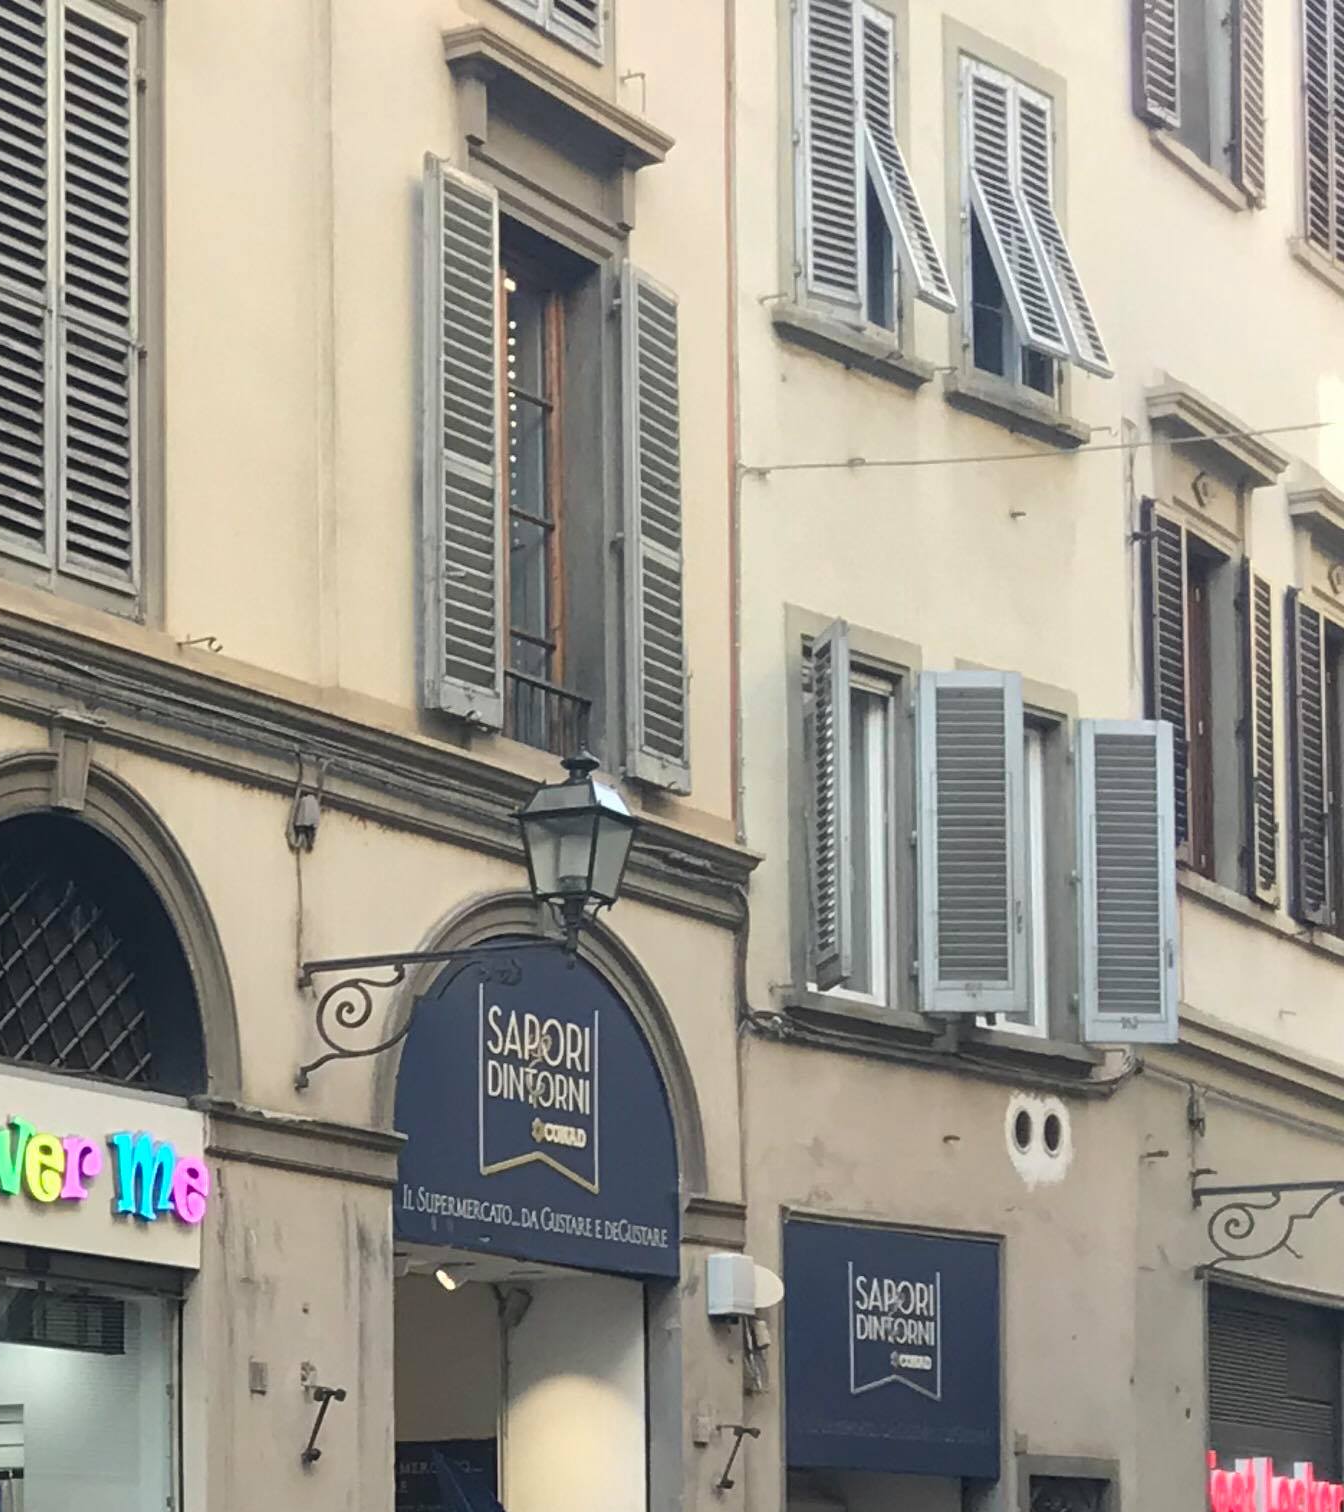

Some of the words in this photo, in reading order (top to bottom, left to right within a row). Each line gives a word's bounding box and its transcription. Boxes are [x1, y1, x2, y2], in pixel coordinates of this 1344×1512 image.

[487, 1005, 591, 1073] SAPORI
[487, 1059, 592, 1115] DINTORNI
[855, 1275, 935, 1317] SAPORI
